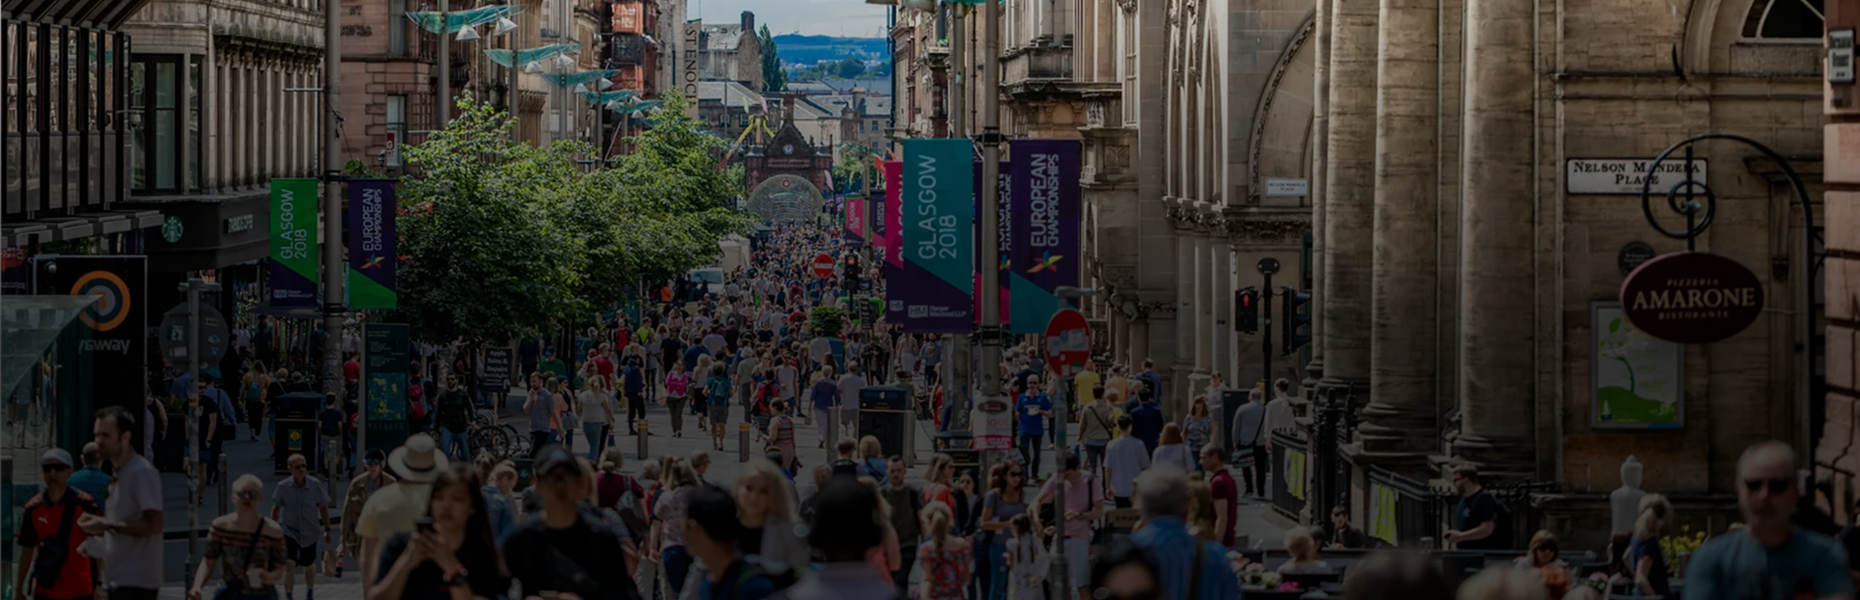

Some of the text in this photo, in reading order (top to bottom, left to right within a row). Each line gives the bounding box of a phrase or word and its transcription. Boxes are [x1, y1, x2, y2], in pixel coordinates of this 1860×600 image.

[1574, 162, 1700, 173] NELSON MNDEA
[280, 188, 294, 260] GLASGOW
[362, 188, 374, 251] EUROPEAN
[374, 188, 382, 251] CHAMPIONSHIPS
[918, 154, 937, 259] GLASGOW
[1030, 153, 1047, 247] EUROPEAN
[1047, 153, 1059, 247] CHAMPIONSHIPS
[294, 229, 307, 259] 2018
[938, 214, 957, 259] 2018
[1632, 287, 1755, 310] AMARONE
[1666, 277, 1720, 287] PIZZERIA
[1658, 310, 1729, 321] RISTORANTE
